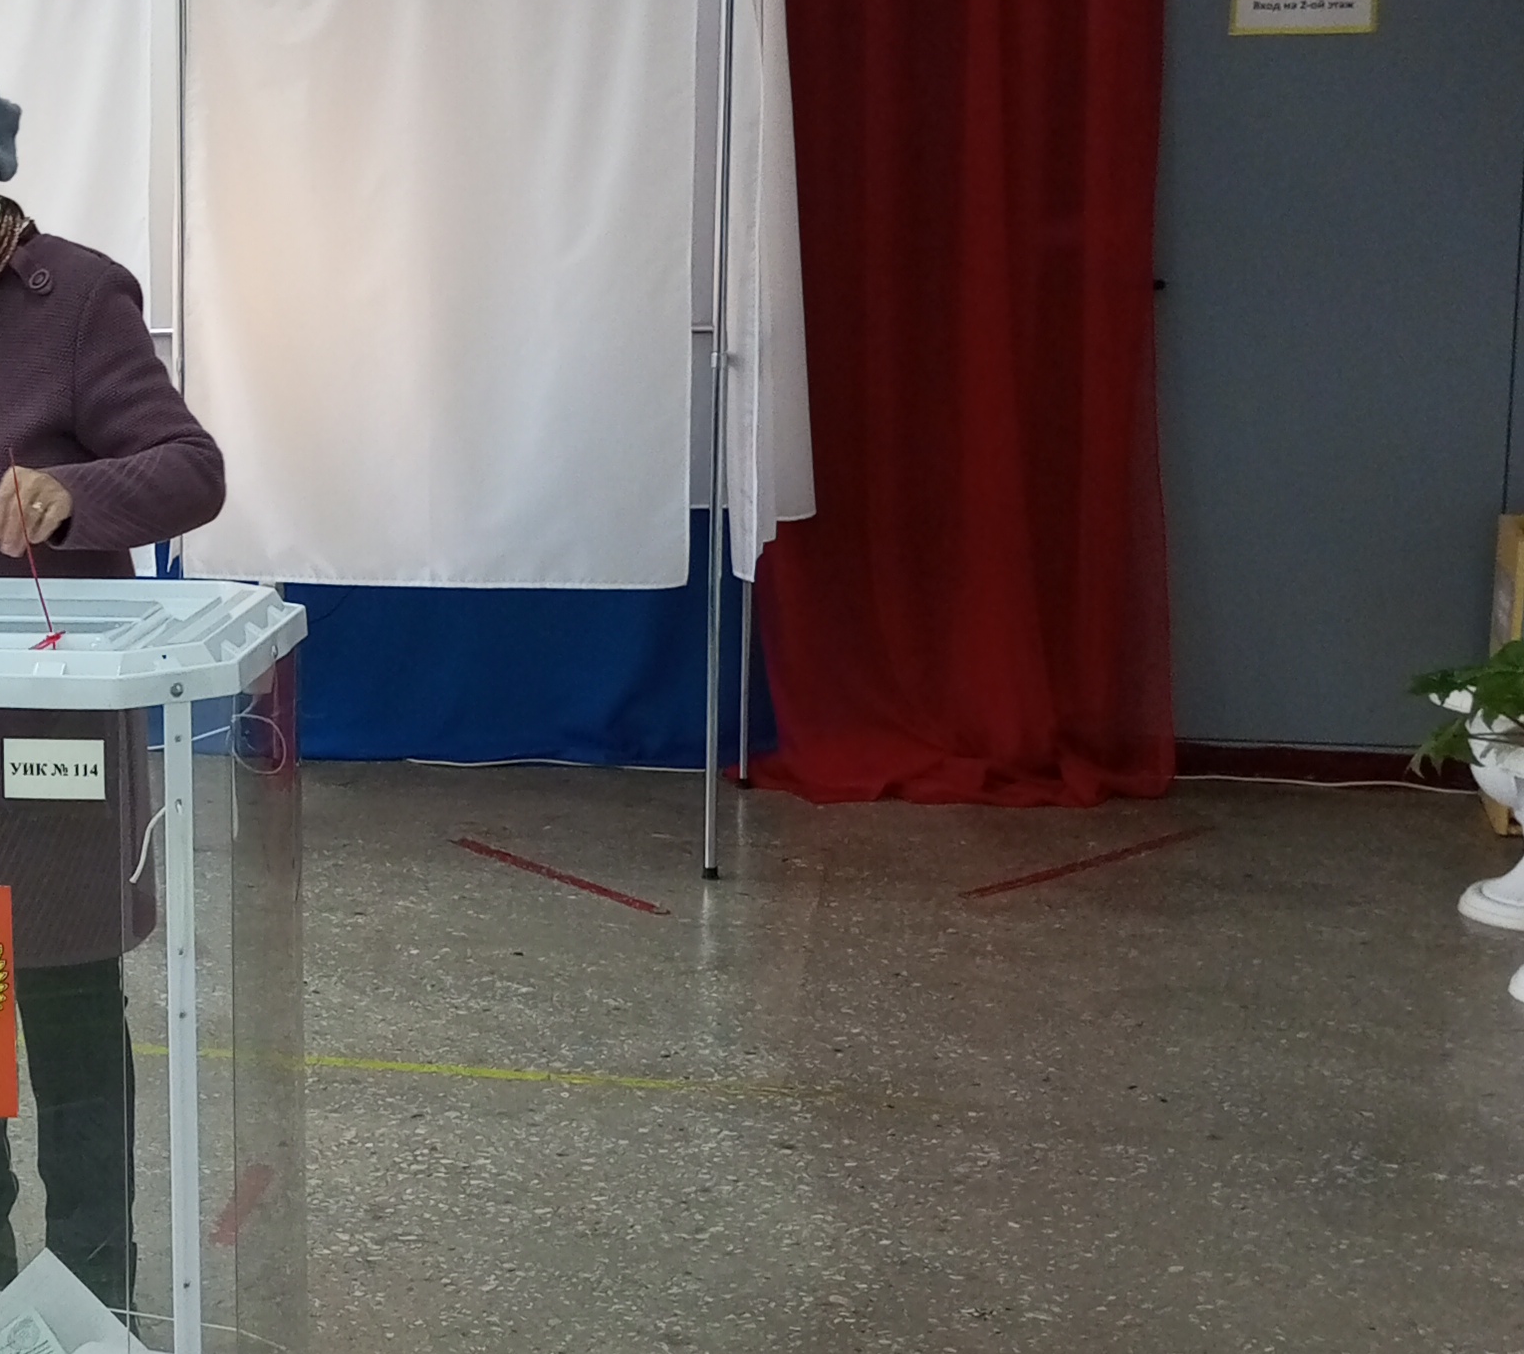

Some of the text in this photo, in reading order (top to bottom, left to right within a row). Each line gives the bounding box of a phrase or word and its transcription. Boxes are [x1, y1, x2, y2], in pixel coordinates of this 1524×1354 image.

[1252, 0, 1356, 12] Вход на 2-ой этаж
[9, 762, 99, 777] УИК № 114
